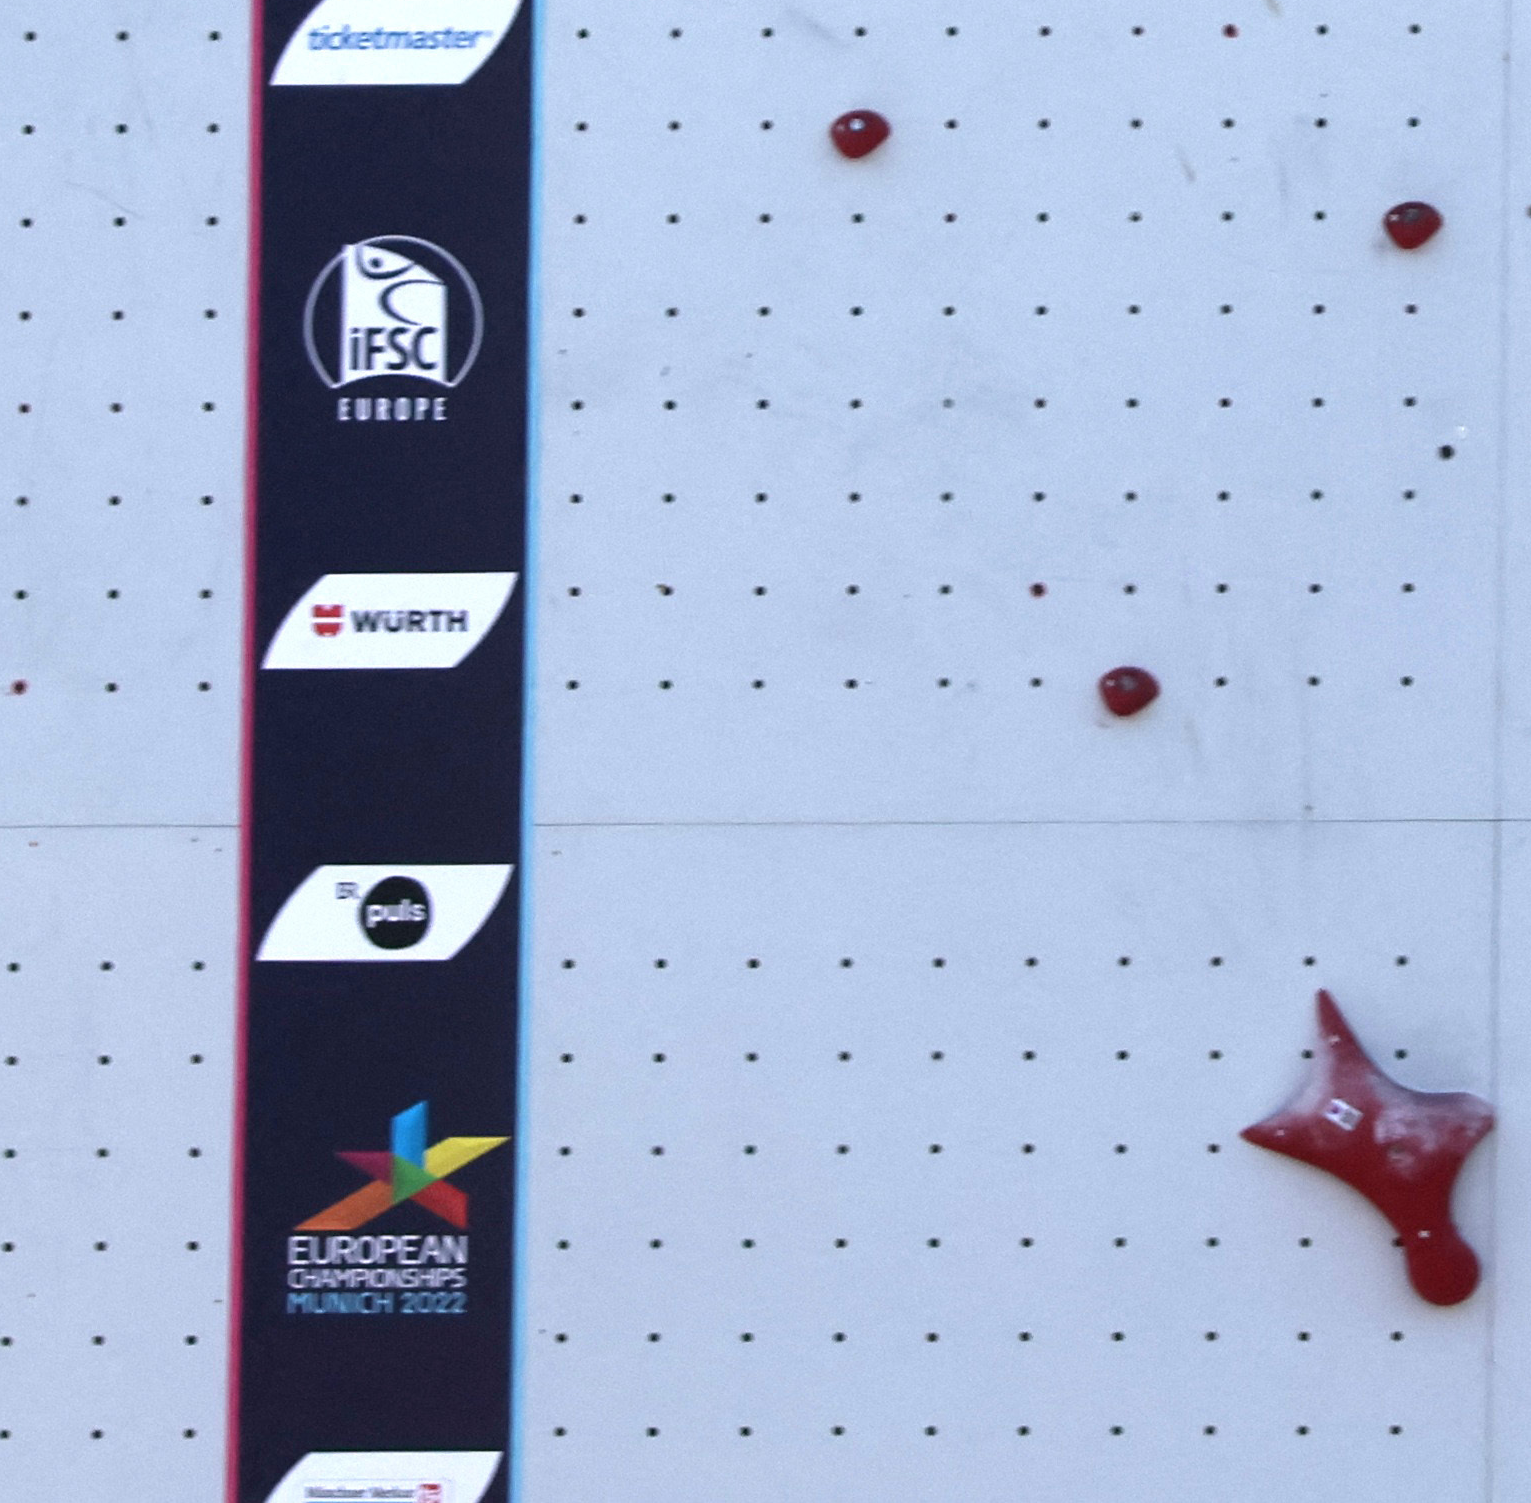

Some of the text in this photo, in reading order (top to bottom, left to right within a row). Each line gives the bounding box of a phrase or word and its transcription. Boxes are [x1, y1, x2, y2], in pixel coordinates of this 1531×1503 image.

[348, 326, 439, 371] iFSC
[336, 397, 449, 421] EUROPE
[366, 898, 427, 928] puls
[287, 1235, 469, 1264] EUROPEAN
[287, 1268, 468, 1288] CHAMPIONSHIPS
[287, 1292, 468, 1314] MUNICH 2022
